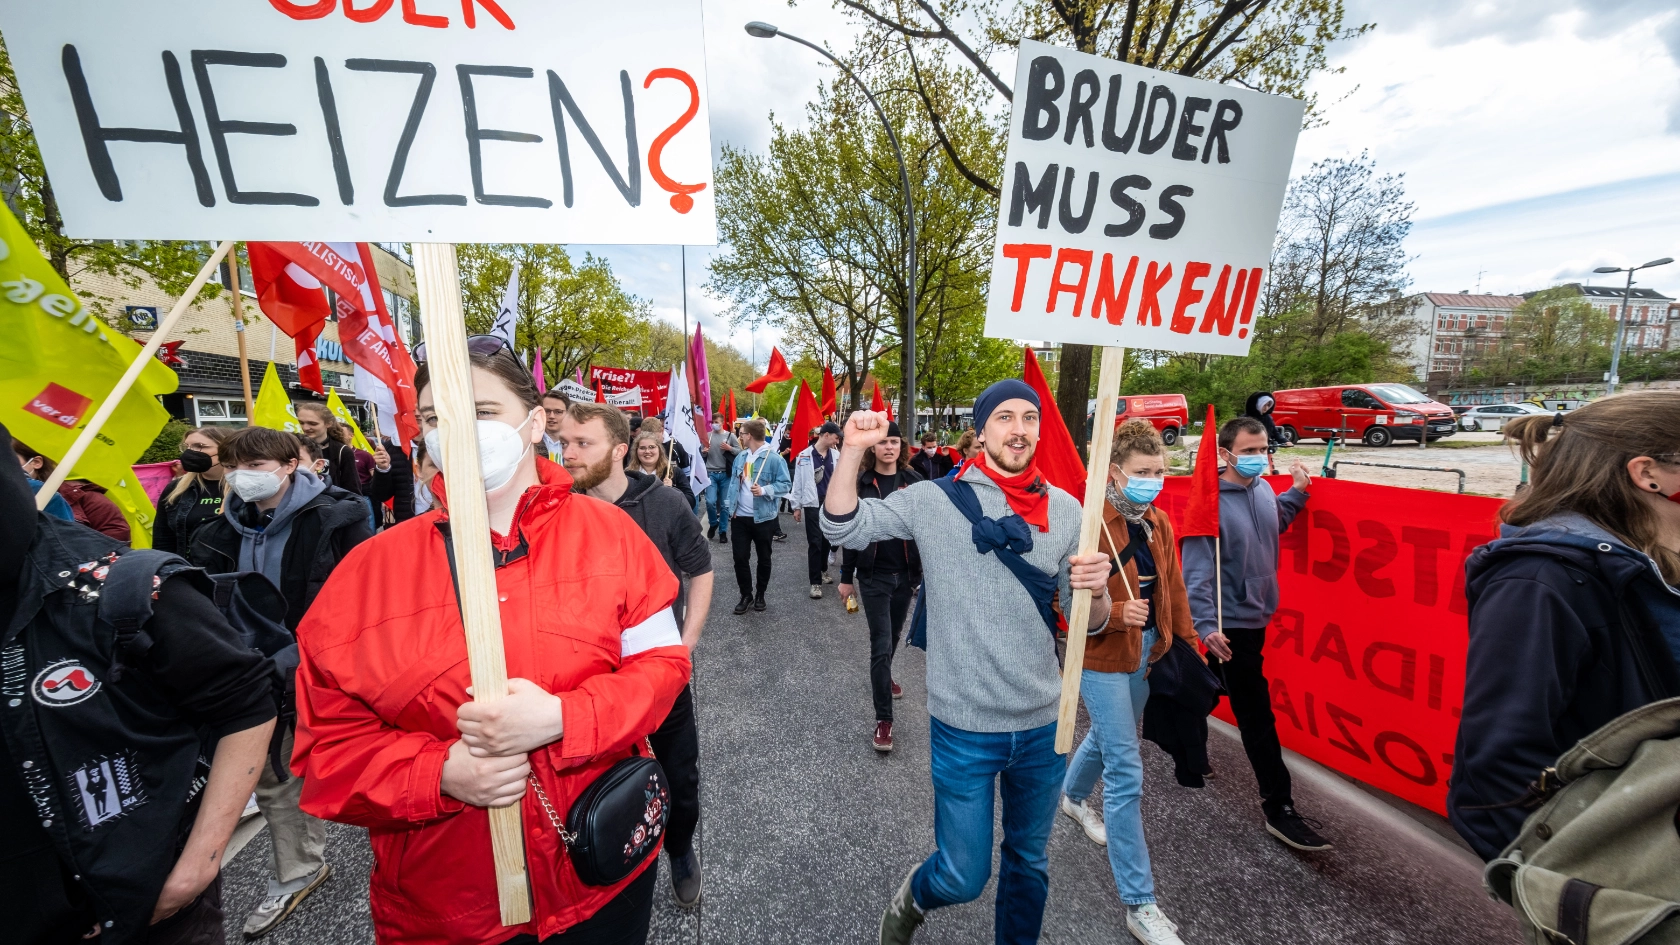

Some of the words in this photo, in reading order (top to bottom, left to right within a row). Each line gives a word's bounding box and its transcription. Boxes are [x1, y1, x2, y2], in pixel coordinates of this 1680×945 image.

[62, 43, 707, 214] HEIZEN?
[1022, 55, 1243, 164] BRUDER
[1008, 161, 1194, 240] MUSS
[1003, 243, 1263, 340] TANKEN!
[32, 399, 78, 427] ver.di
[592, 368, 636, 384] Krise?!
[121, 795, 138, 807] SKA
